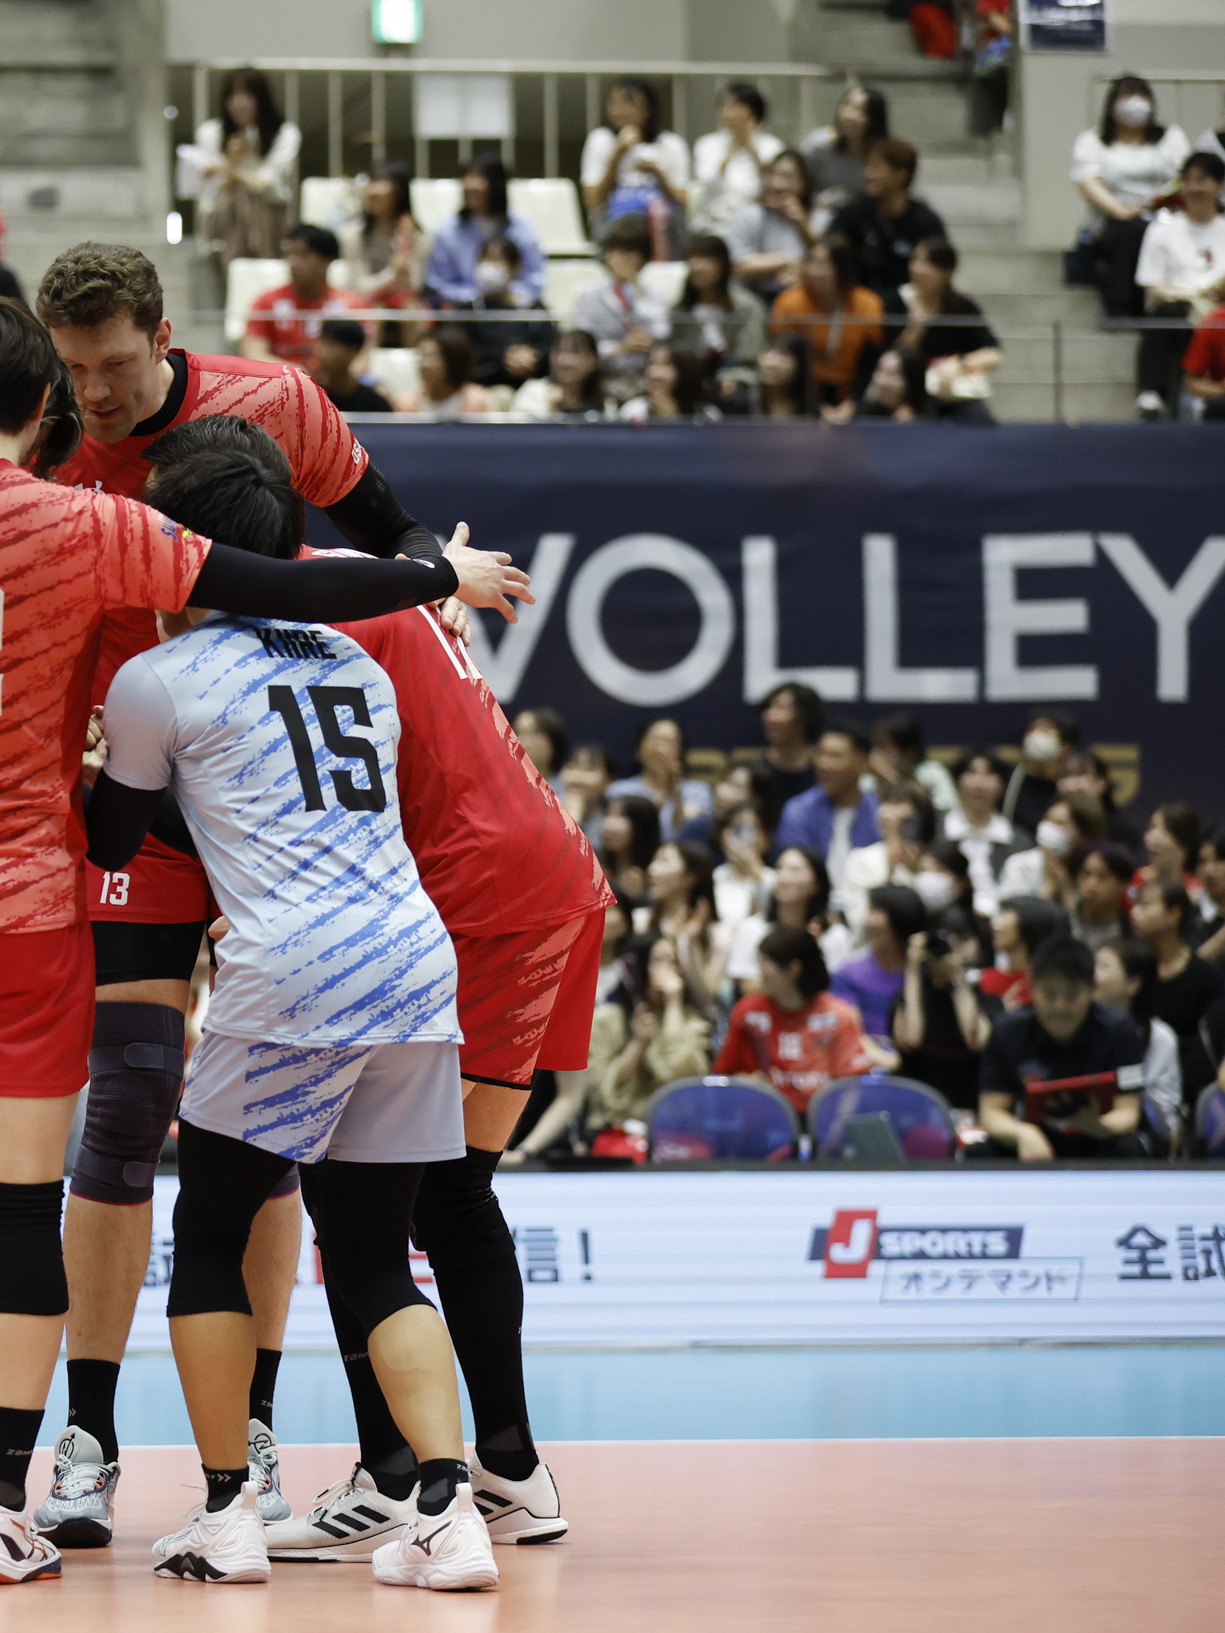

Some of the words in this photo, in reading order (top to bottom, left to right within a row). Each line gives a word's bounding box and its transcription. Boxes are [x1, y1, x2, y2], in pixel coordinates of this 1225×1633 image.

[268, 685, 387, 812] 15
[99, 871, 131, 906] 13
[878, 1230, 1009, 1259] SPORTS
[901, 1267, 1067, 1296] オンデマンド
